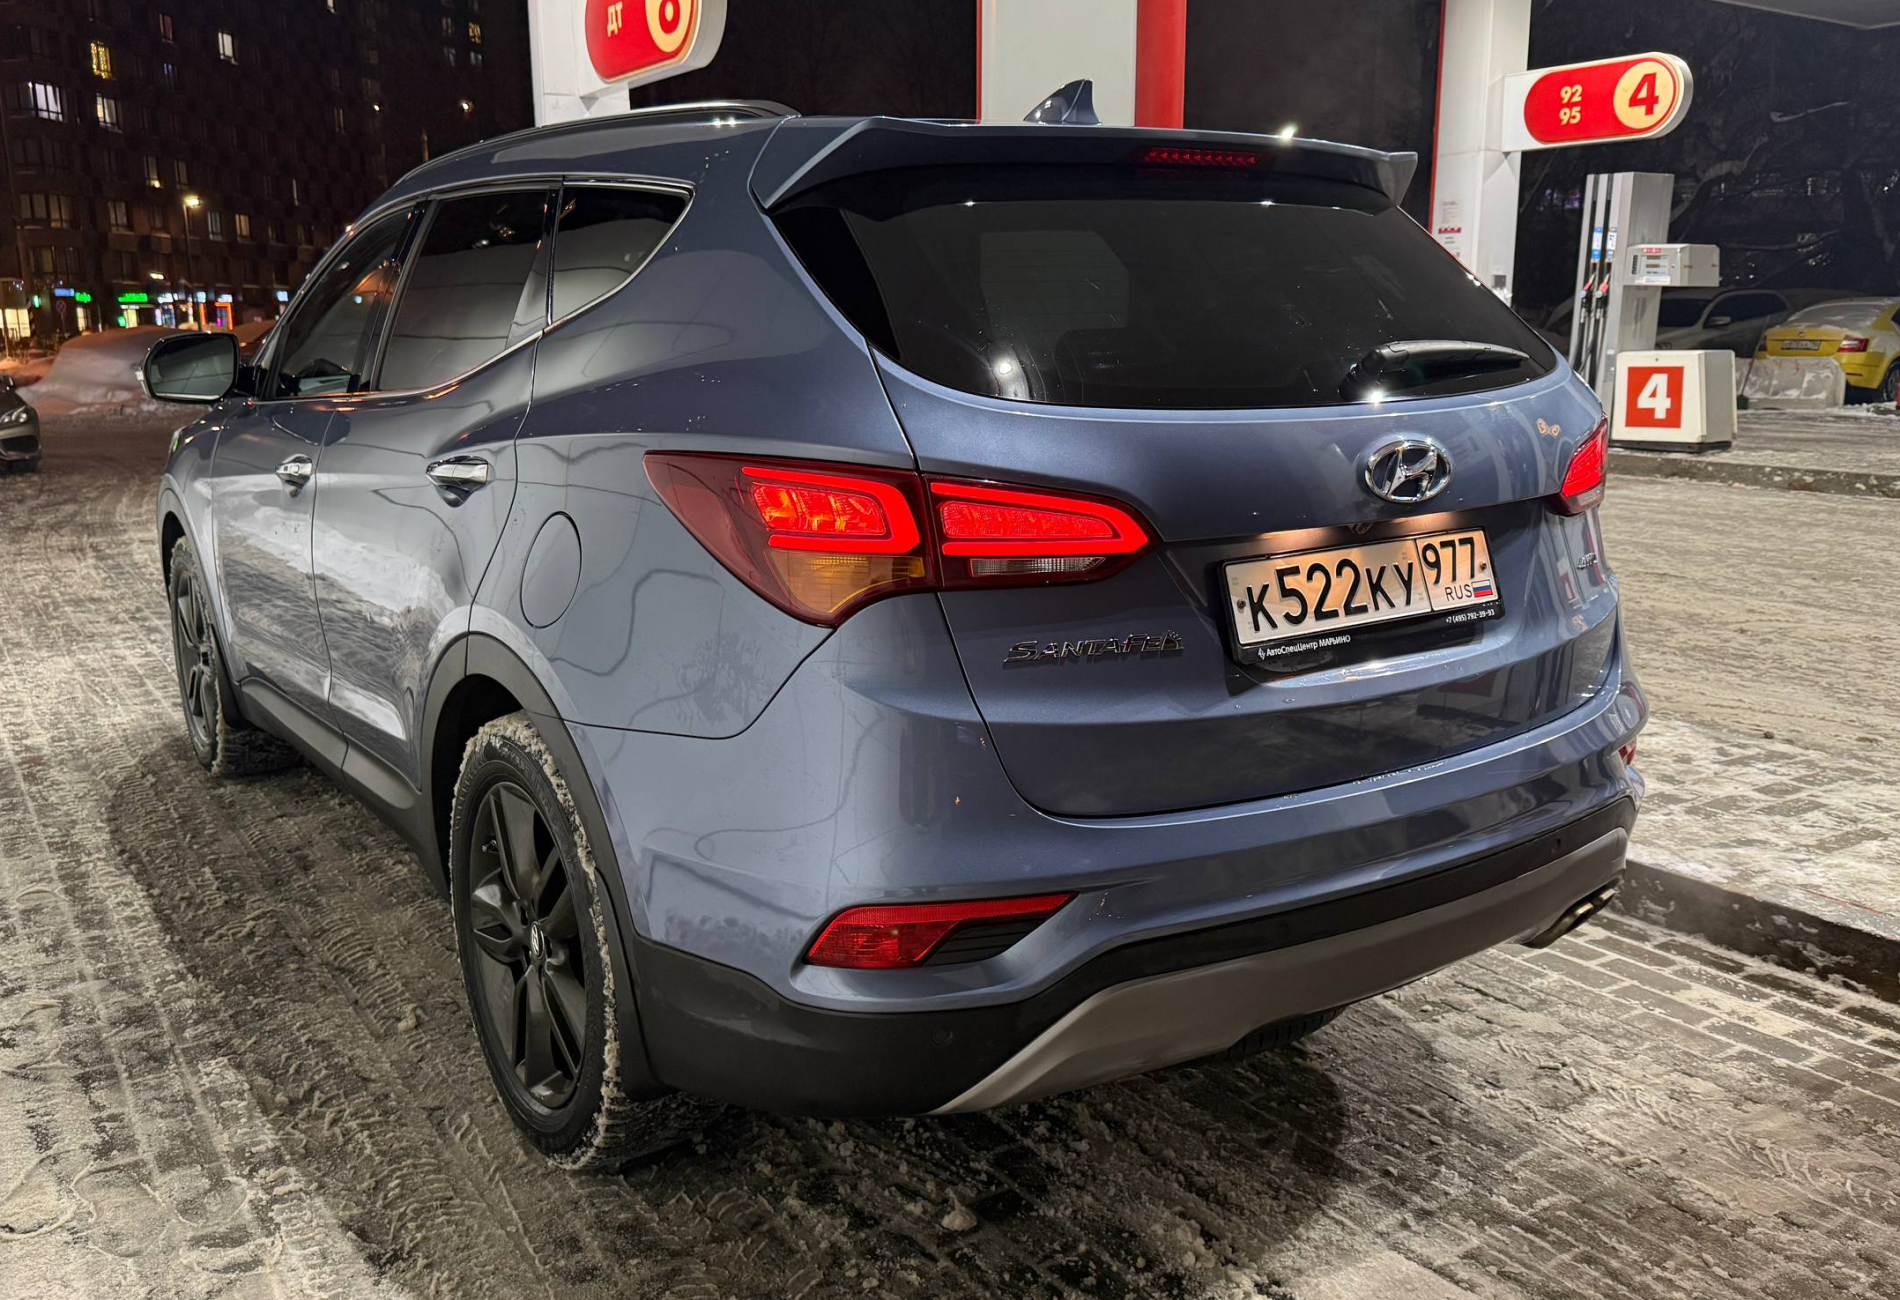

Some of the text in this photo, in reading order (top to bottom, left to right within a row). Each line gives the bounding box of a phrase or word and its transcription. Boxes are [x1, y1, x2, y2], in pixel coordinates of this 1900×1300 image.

[607, 2, 623, 37] ДТ
[1561, 84, 1583, 104] 92
[1628, 72, 1659, 116] 4
[1559, 106, 1581, 126] 95
[1637, 373, 1671, 419] 4
[1422, 537, 1475, 585] 977
[1444, 584, 1473, 601] RUS
[1319, 634, 1351, 648] МАРЬИНО
